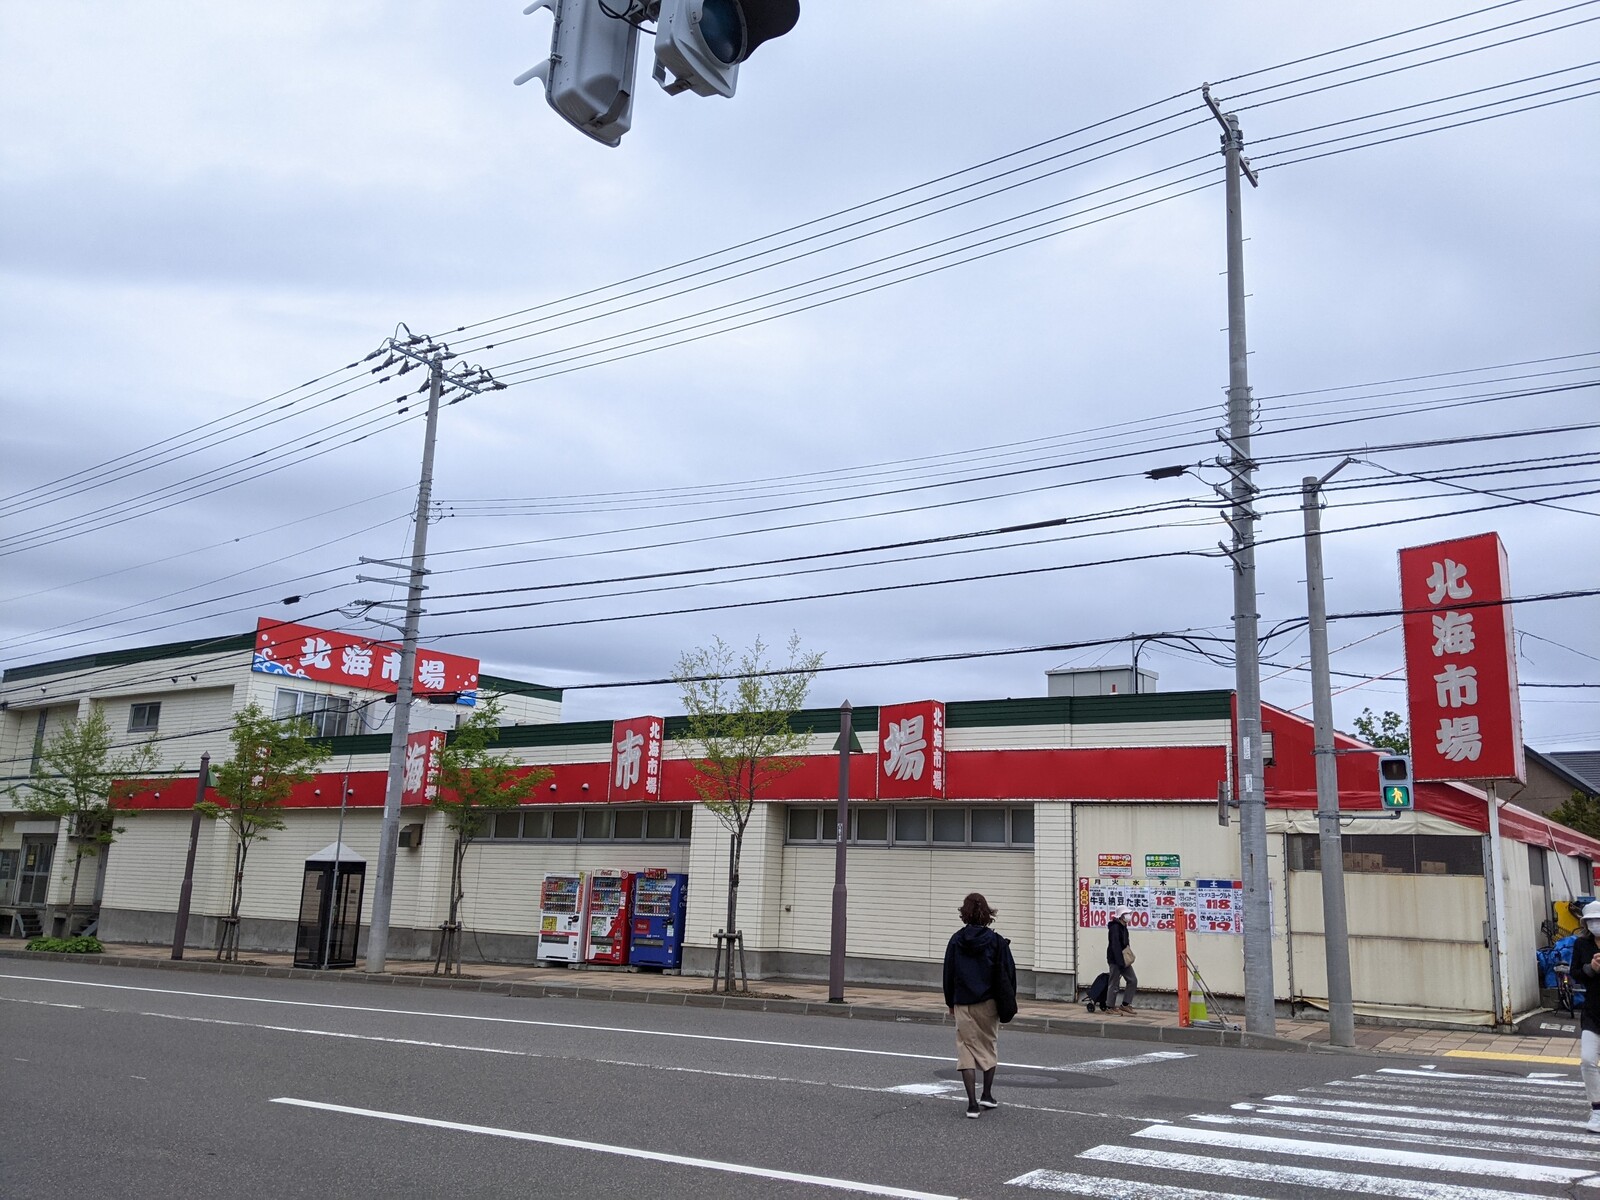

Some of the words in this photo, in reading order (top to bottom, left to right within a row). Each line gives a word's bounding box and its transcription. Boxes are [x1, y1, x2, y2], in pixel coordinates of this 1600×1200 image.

[300, 637, 446, 690] 北海市場
[1426, 559, 1482, 761] 北海市場
[883, 710, 927, 780] 場
[933, 702, 942, 790] 北海市場
[616, 730, 644, 790] 市
[646, 722, 660, 794] 北海市場
[403, 742, 427, 795] 海
[1090, 896, 1107, 906] 牛乳
[1108, 896, 1125, 906] 納豆
[1126, 898, 1149, 908] たまご
[1156, 896, 1175, 906] 18
[1206, 899, 1231, 909] 118
[1090, 910, 1107, 926] 108
[1128, 911, 1149, 927] 00
[1209, 922, 1231, 931] 19
